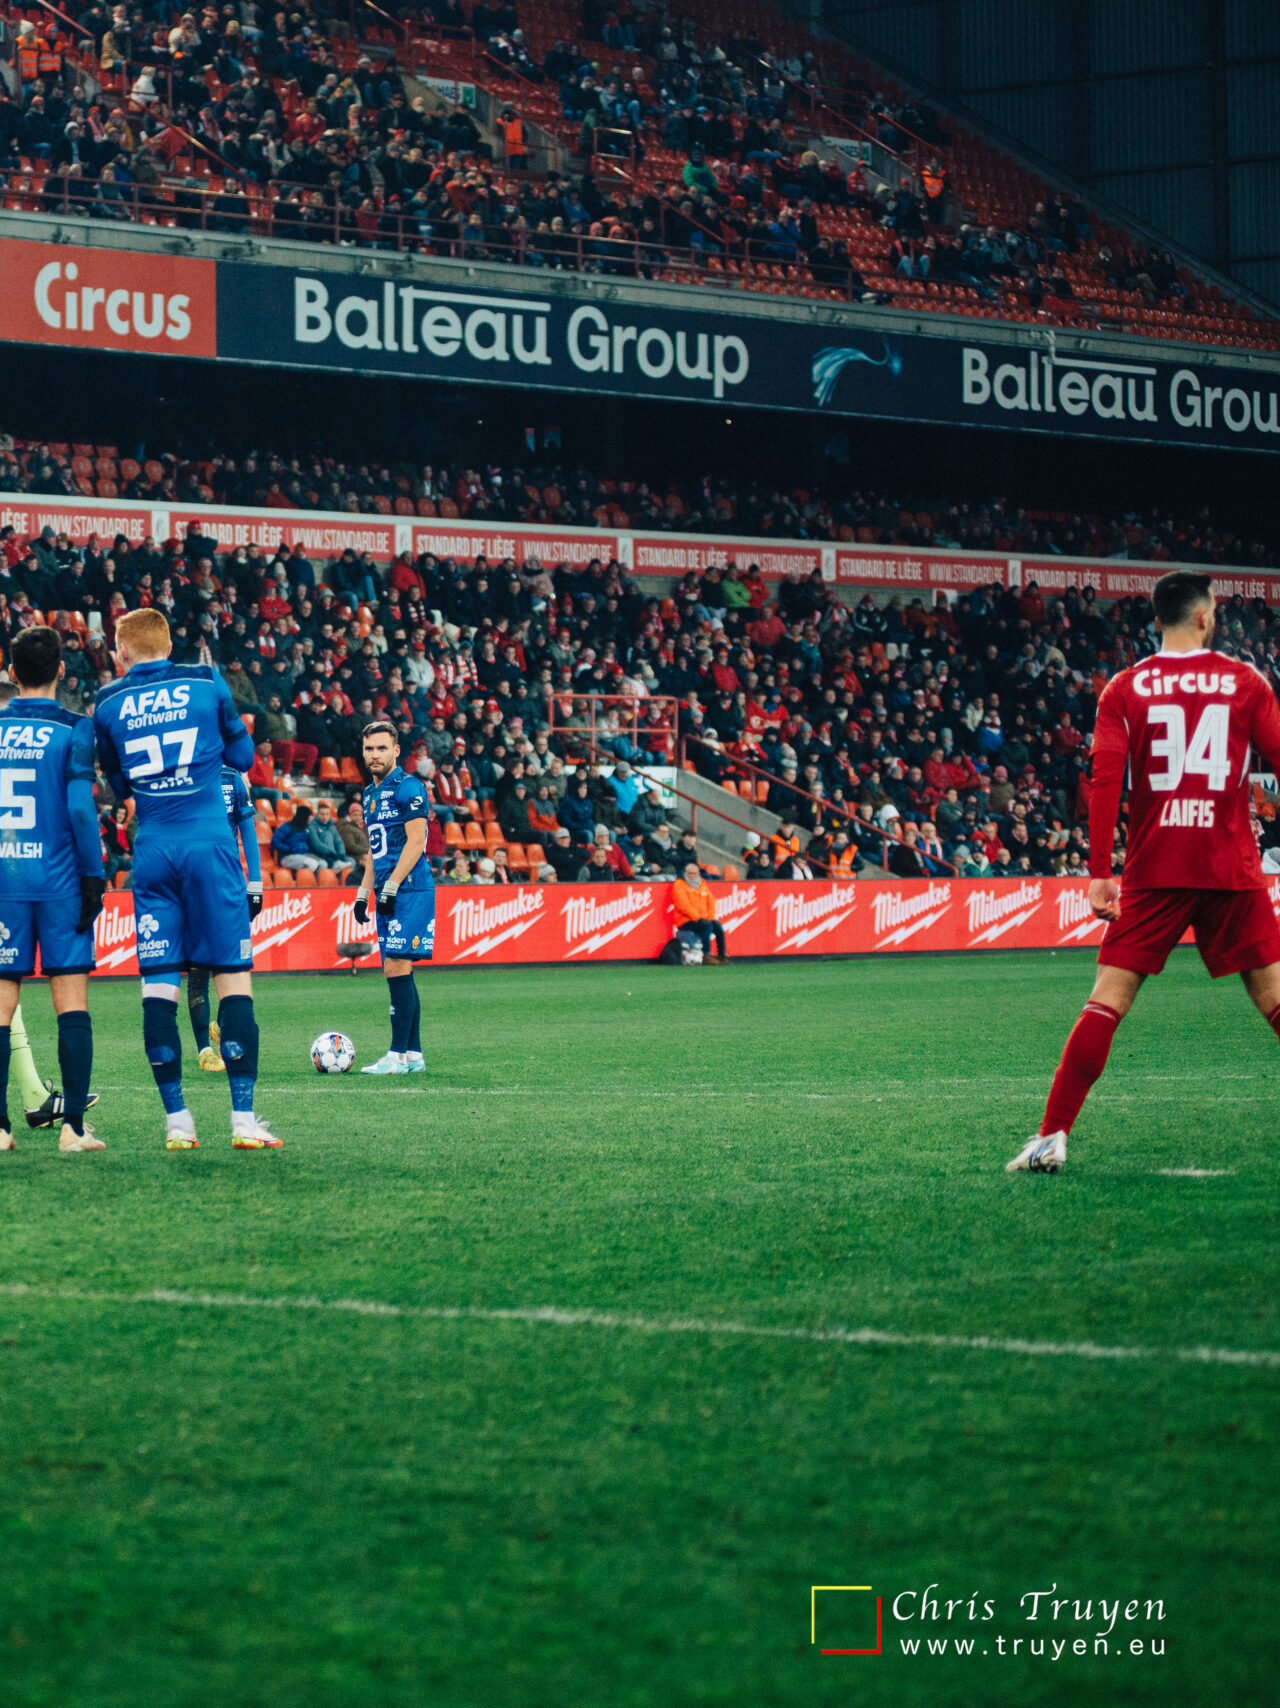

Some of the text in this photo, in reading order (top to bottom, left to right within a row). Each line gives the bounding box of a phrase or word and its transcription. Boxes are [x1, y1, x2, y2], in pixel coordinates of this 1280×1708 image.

[35, 262, 192, 341] Circus
[567, 305, 750, 398] Group
[38, 513, 144, 540] WWW.STANDARD.BE
[235, 525, 249, 547] DE
[252, 522, 282, 546] LIÈGE
[292, 527, 389, 553] WWW.STANDARD.BE
[417, 534, 612, 564] STANDARD DE LIÈGE WWW.STANDARD.BE
[637, 546, 686, 568] STANDARD
[687, 548, 700, 568] DE
[701, 547, 728, 570] LIÈGE
[839, 558, 885, 578] STANDARD
[885, 560, 897, 579] DE
[898, 558, 922, 580] LIÈGE
[1067, 571, 1078, 589] DE
[1078, 569, 1101, 590] LIÈGE
[1133, 668, 1237, 697] Circus
[119, 685, 190, 720] AFAS
[127, 708, 188, 730] software
[1147, 703, 1231, 792] 34
[377, 809, 399, 821] AFAS
[1159, 798, 1215, 828] LAIFIS
[447, 887, 545, 945] Milwaukee
[561, 886, 653, 943] Milwaukee
[771, 883, 856, 937] Milwaukee
[871, 881, 951, 935] Milwaukee
[965, 880, 1043, 933] Milwaukee
